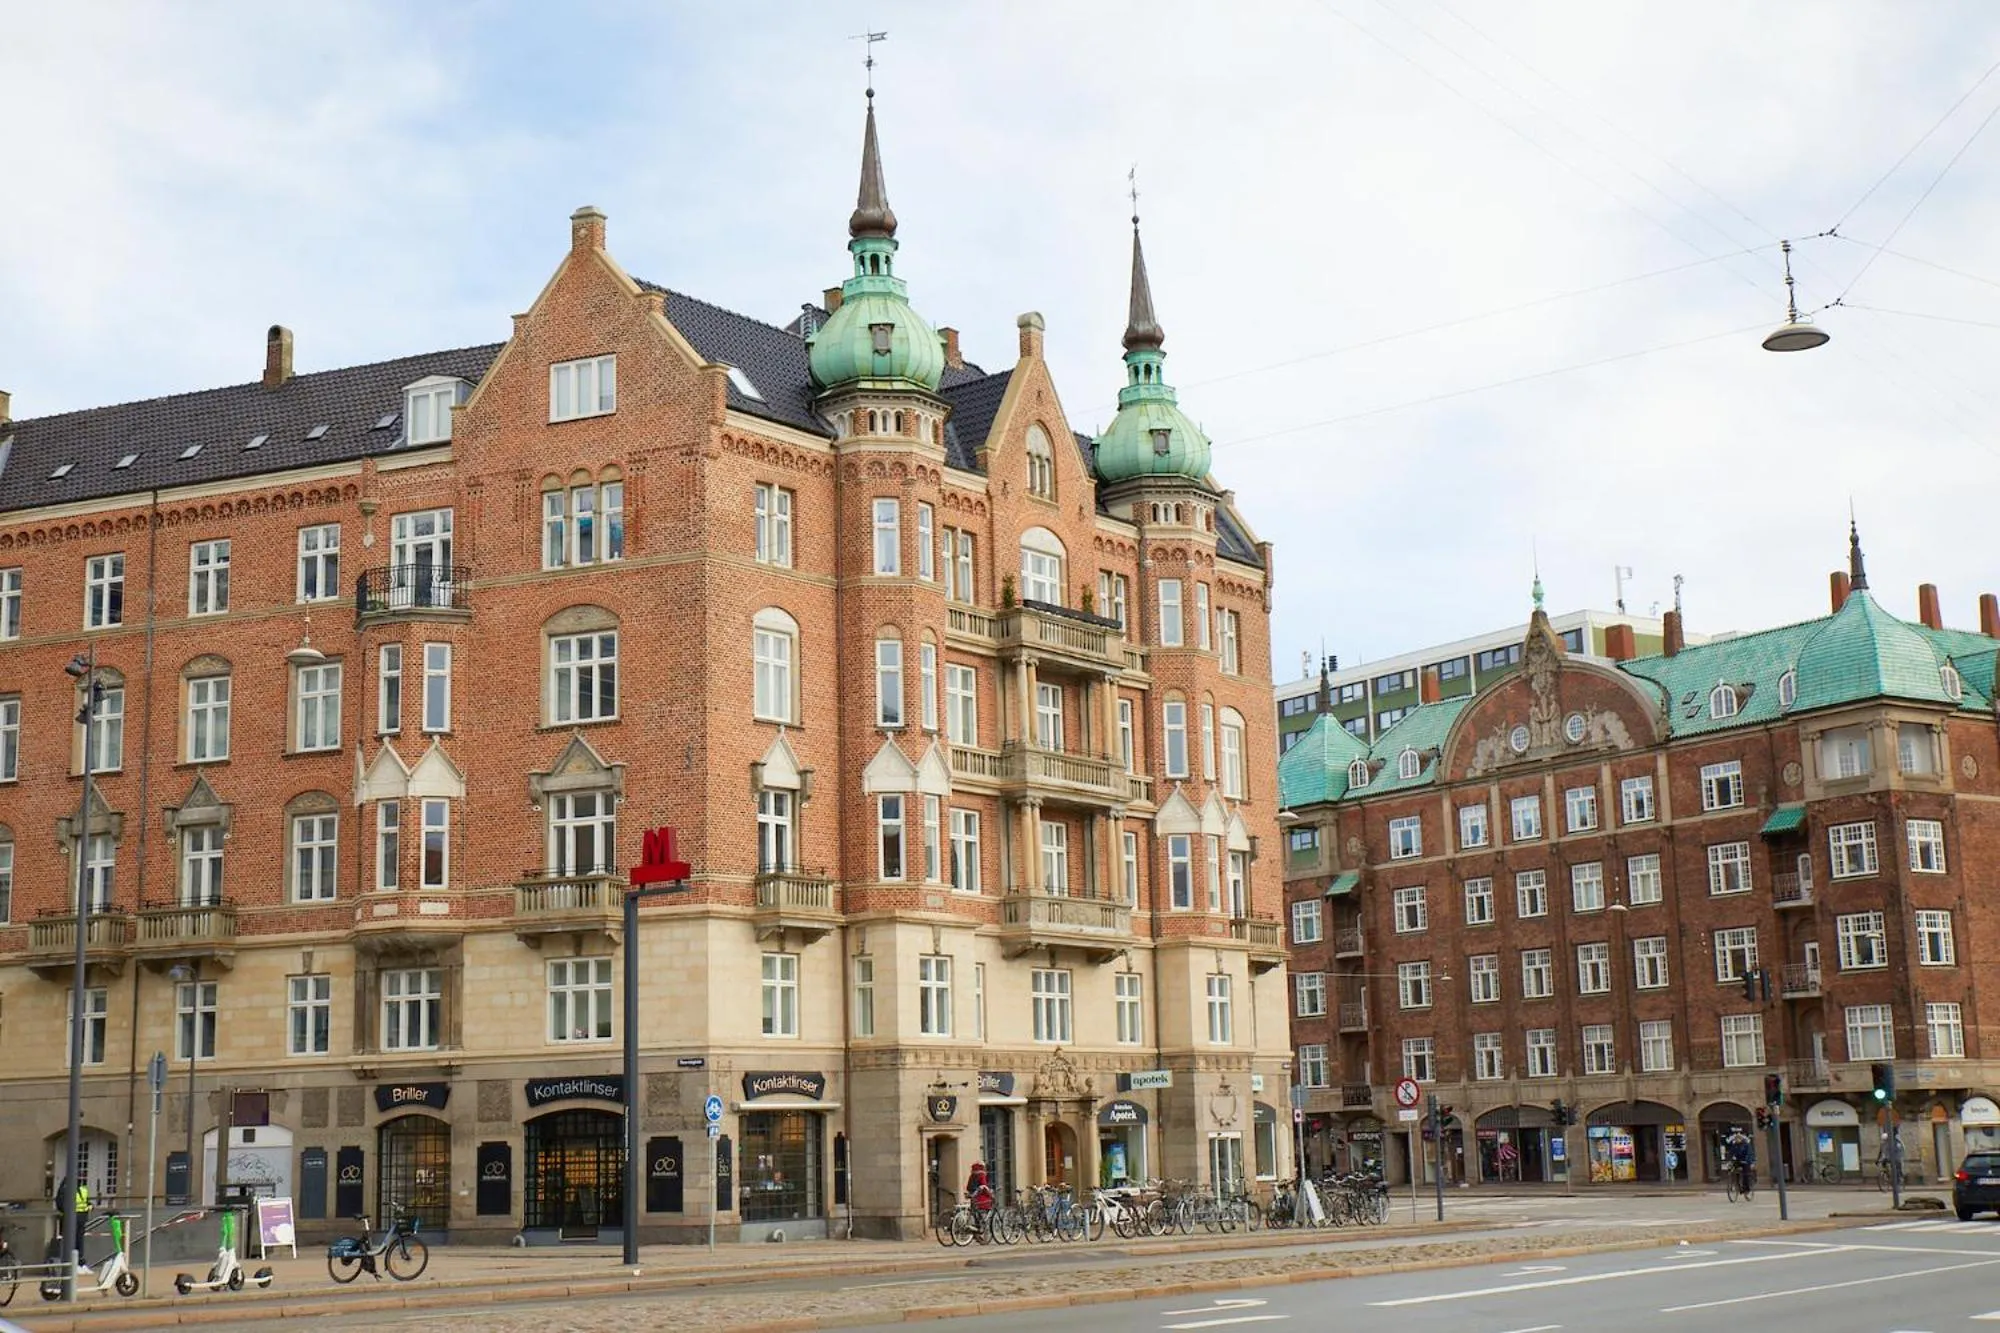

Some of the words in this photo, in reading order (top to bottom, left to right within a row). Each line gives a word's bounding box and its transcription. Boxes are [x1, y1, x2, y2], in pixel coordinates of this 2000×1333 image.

[642, 827, 676, 864] M
[753, 1075, 818, 1094] Kontaktlinser
[1133, 1074, 1168, 1086] apotek
[392, 1087, 429, 1102] Briller
[534, 1079, 618, 1099] Kontaktlinser
[1110, 1109, 1137, 1122] Apotek
